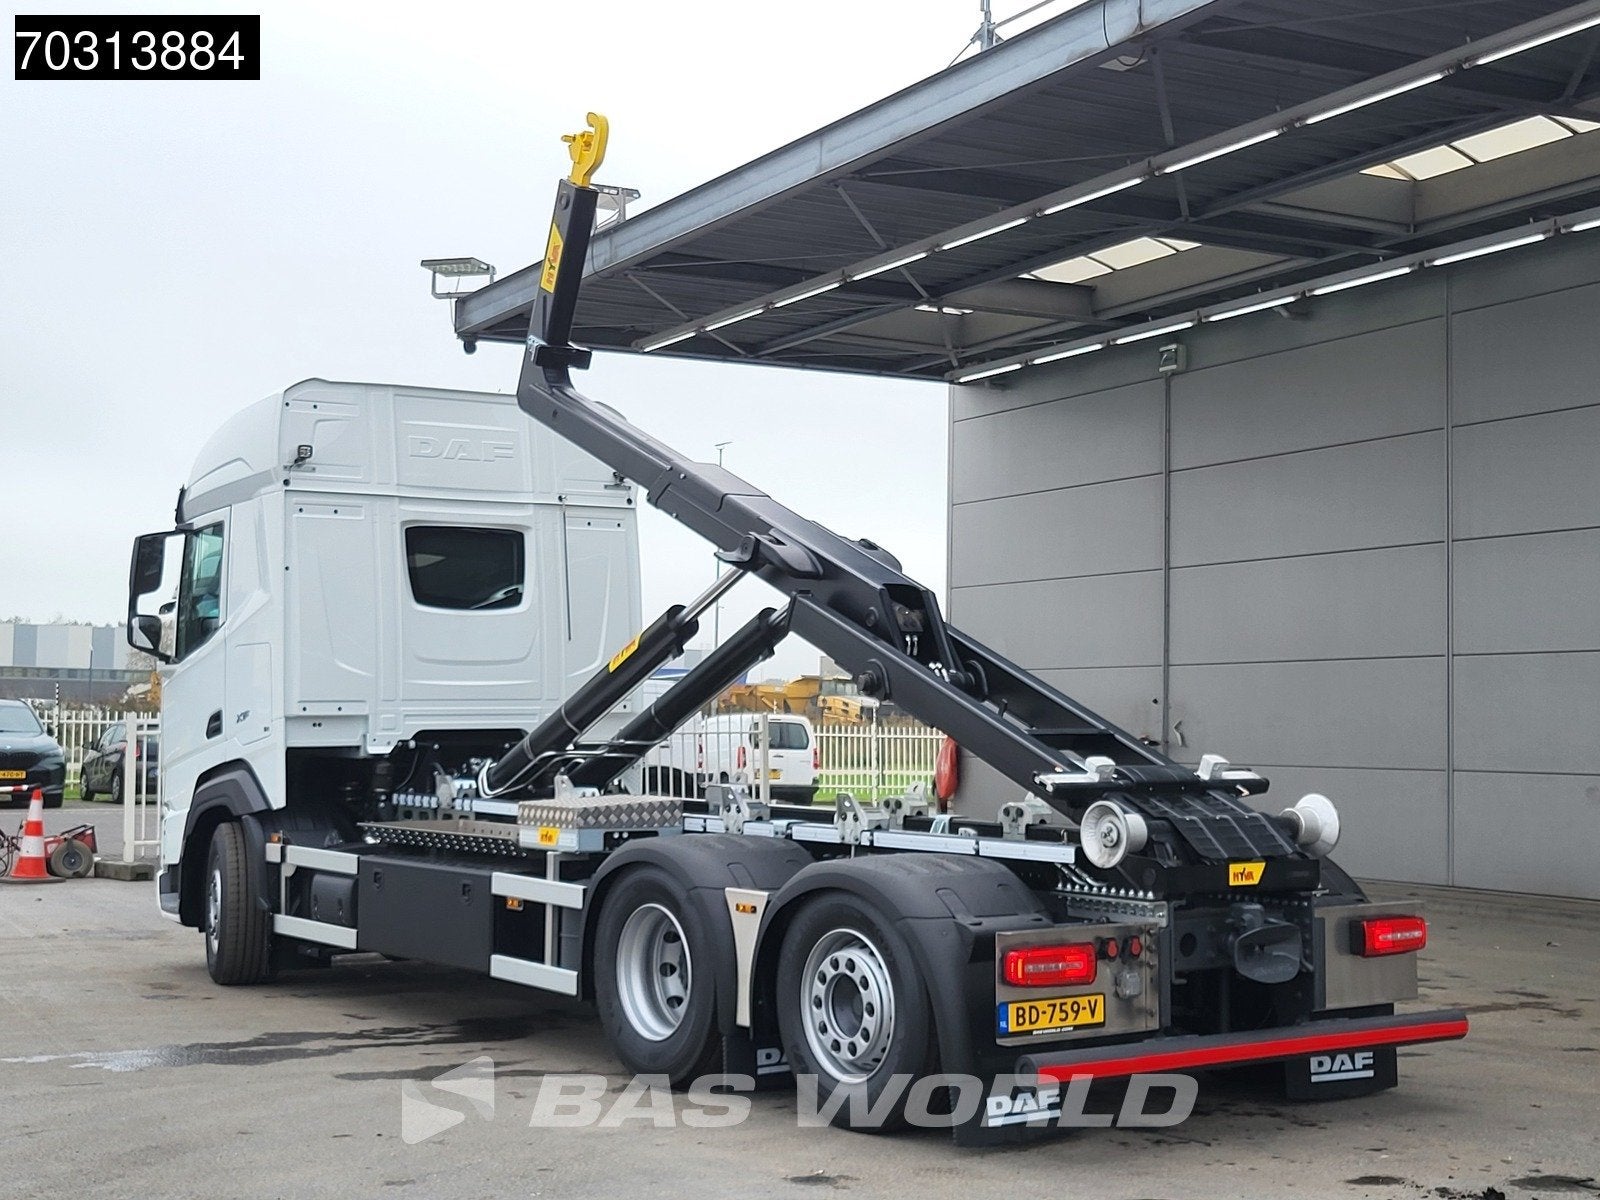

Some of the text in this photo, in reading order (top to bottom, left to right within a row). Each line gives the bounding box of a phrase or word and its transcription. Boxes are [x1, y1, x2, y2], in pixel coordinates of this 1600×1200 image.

[408, 435, 514, 462] DAF
[1233, 867, 1254, 882] HYVA
[1016, 999, 1098, 1026] BD-759-V
[1310, 1051, 1374, 1074] DAF
[986, 1088, 1060, 1116] DAF
